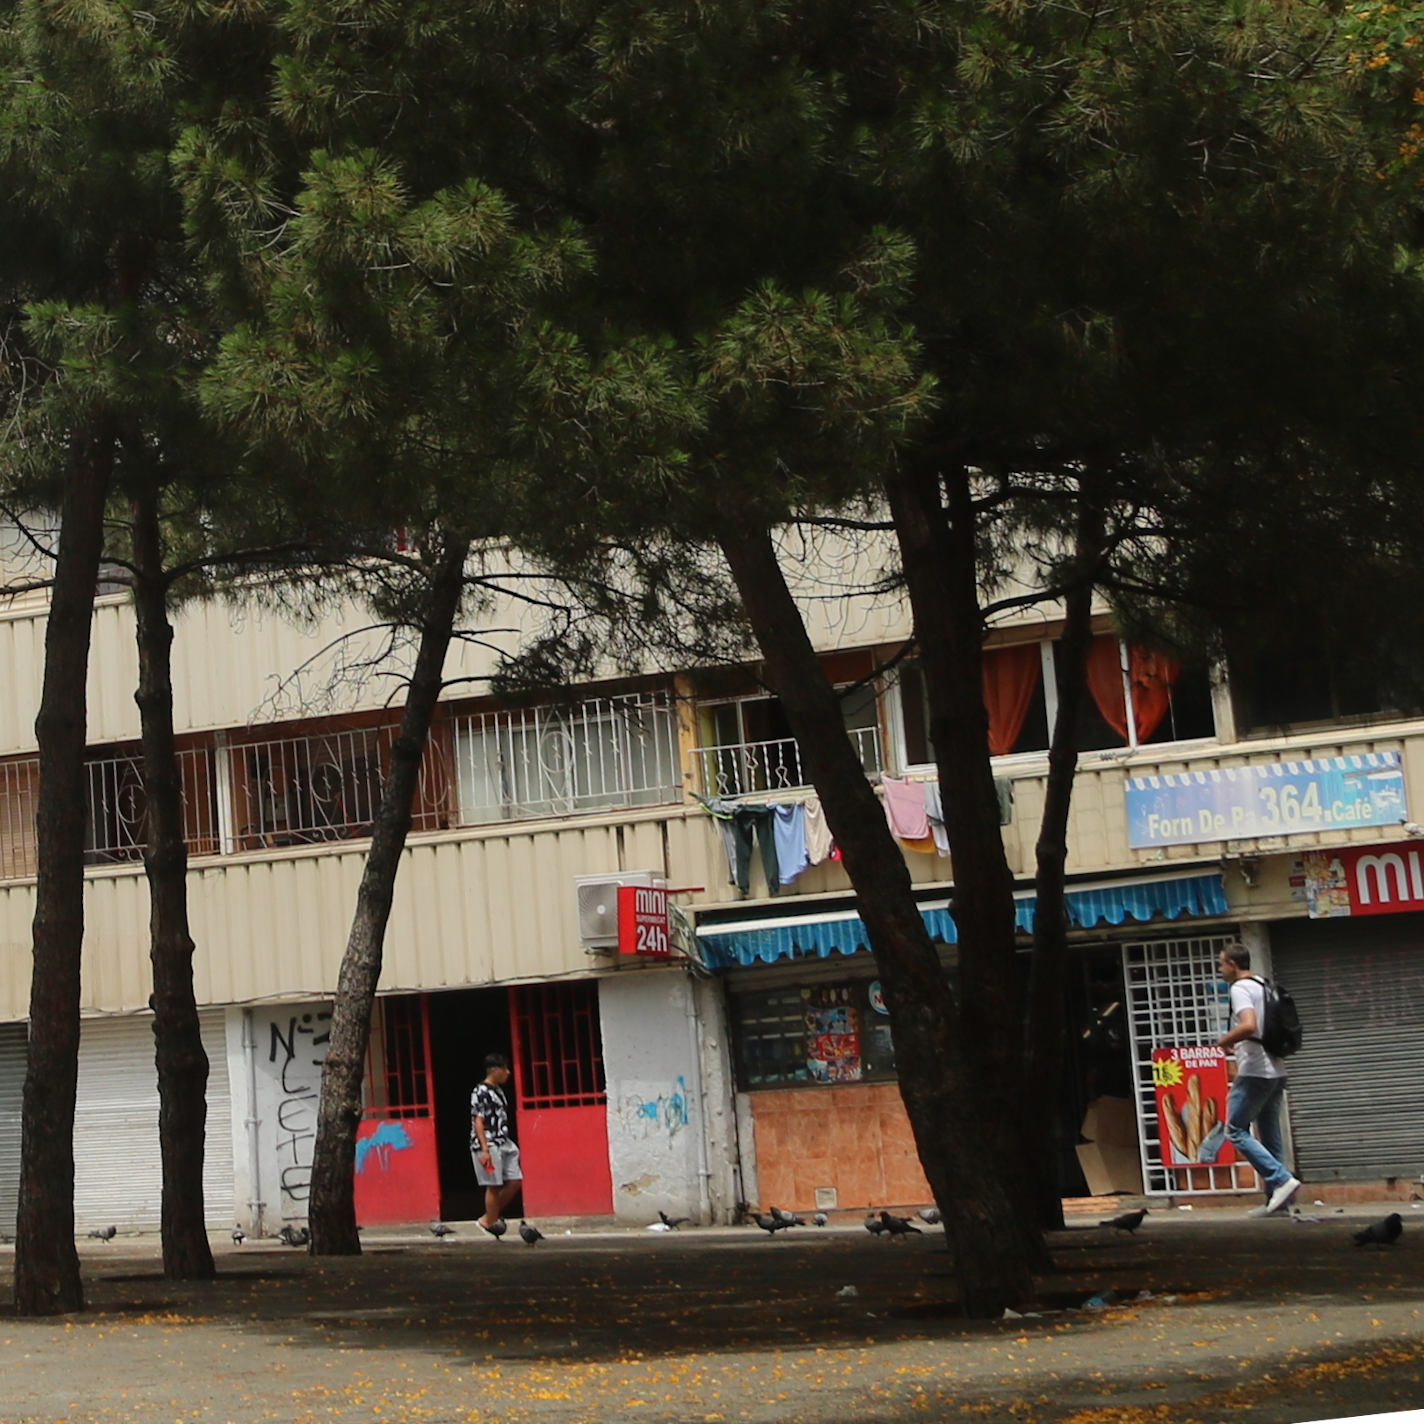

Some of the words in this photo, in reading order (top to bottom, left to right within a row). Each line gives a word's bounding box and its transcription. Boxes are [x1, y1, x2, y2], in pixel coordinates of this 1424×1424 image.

[1148, 814, 1192, 838] Forn
[1199, 809, 1225, 834] De
[637, 925, 667, 952] 24h
[1171, 1049, 1179, 1060] 3
[1180, 1046, 1225, 1060] BARRAS
[1185, 1059, 1198, 1068] DE
[1199, 1059, 1218, 1068] PAN
